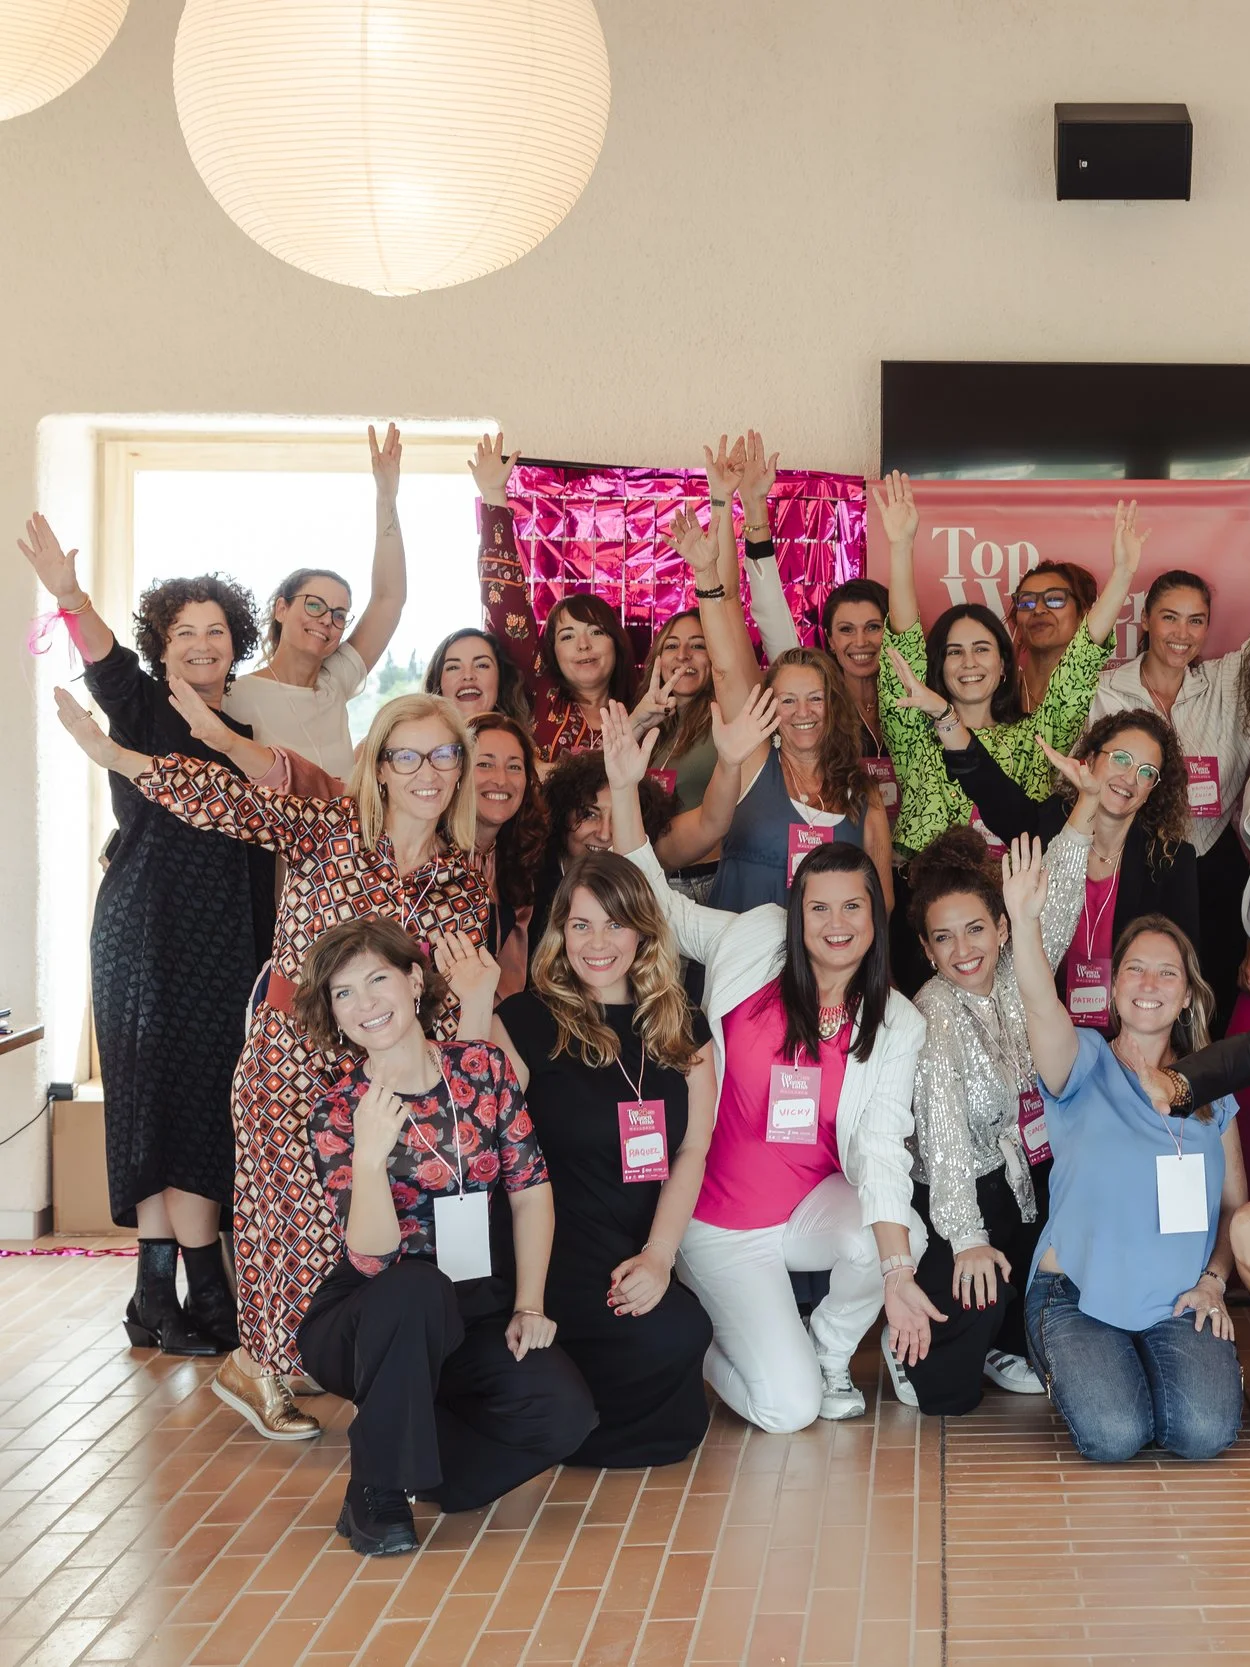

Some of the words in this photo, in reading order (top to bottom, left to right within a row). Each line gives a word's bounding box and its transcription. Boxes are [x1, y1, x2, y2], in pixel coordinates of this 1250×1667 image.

[932, 527, 1039, 596] Top
[780, 1108, 811, 1116] VICKY
[629, 1147, 660, 1158] RAQUEL
